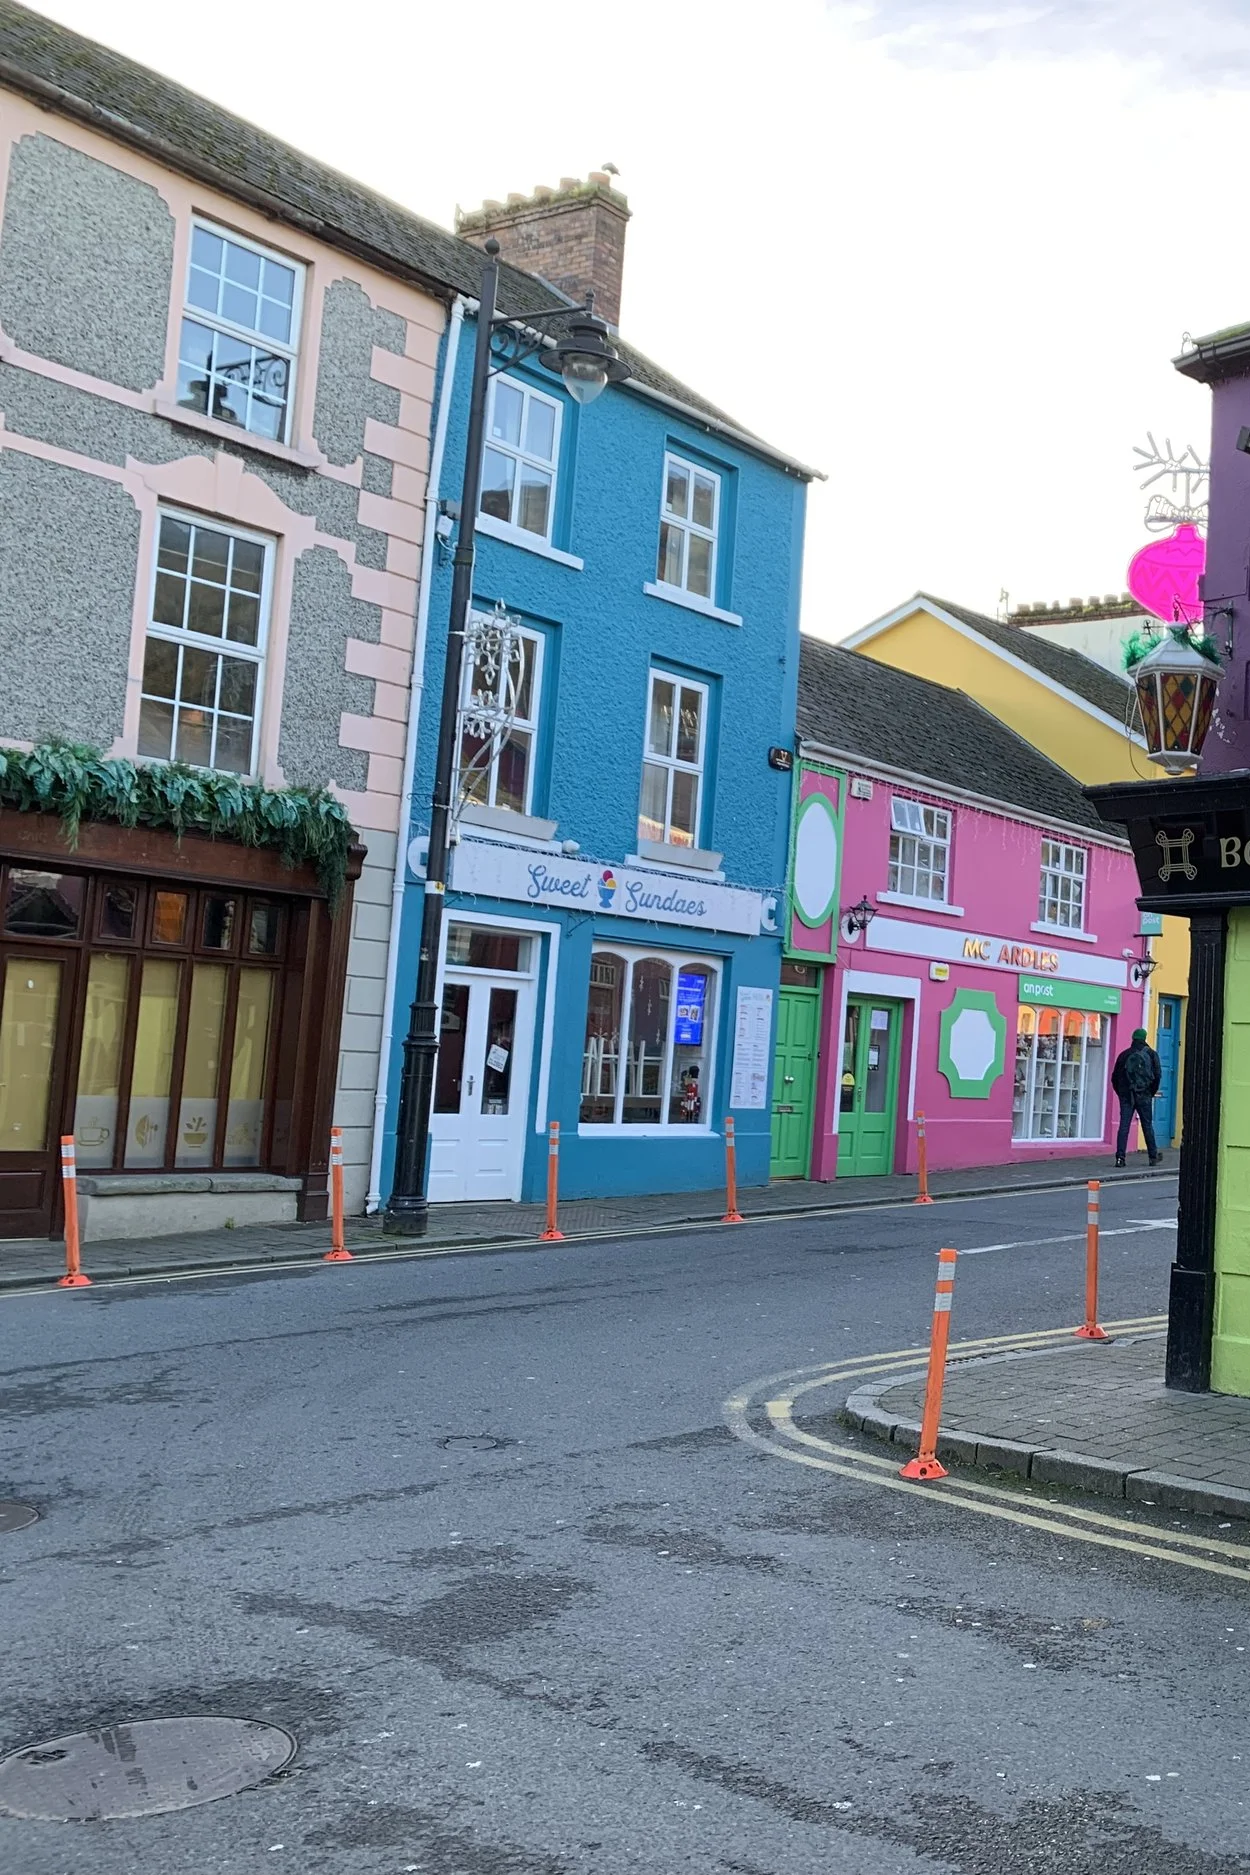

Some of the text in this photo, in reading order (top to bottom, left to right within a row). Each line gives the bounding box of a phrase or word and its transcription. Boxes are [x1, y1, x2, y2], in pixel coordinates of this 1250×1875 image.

[526, 863, 707, 917] Sweet Sundaes
[997, 943, 1060, 973] ARDLES
